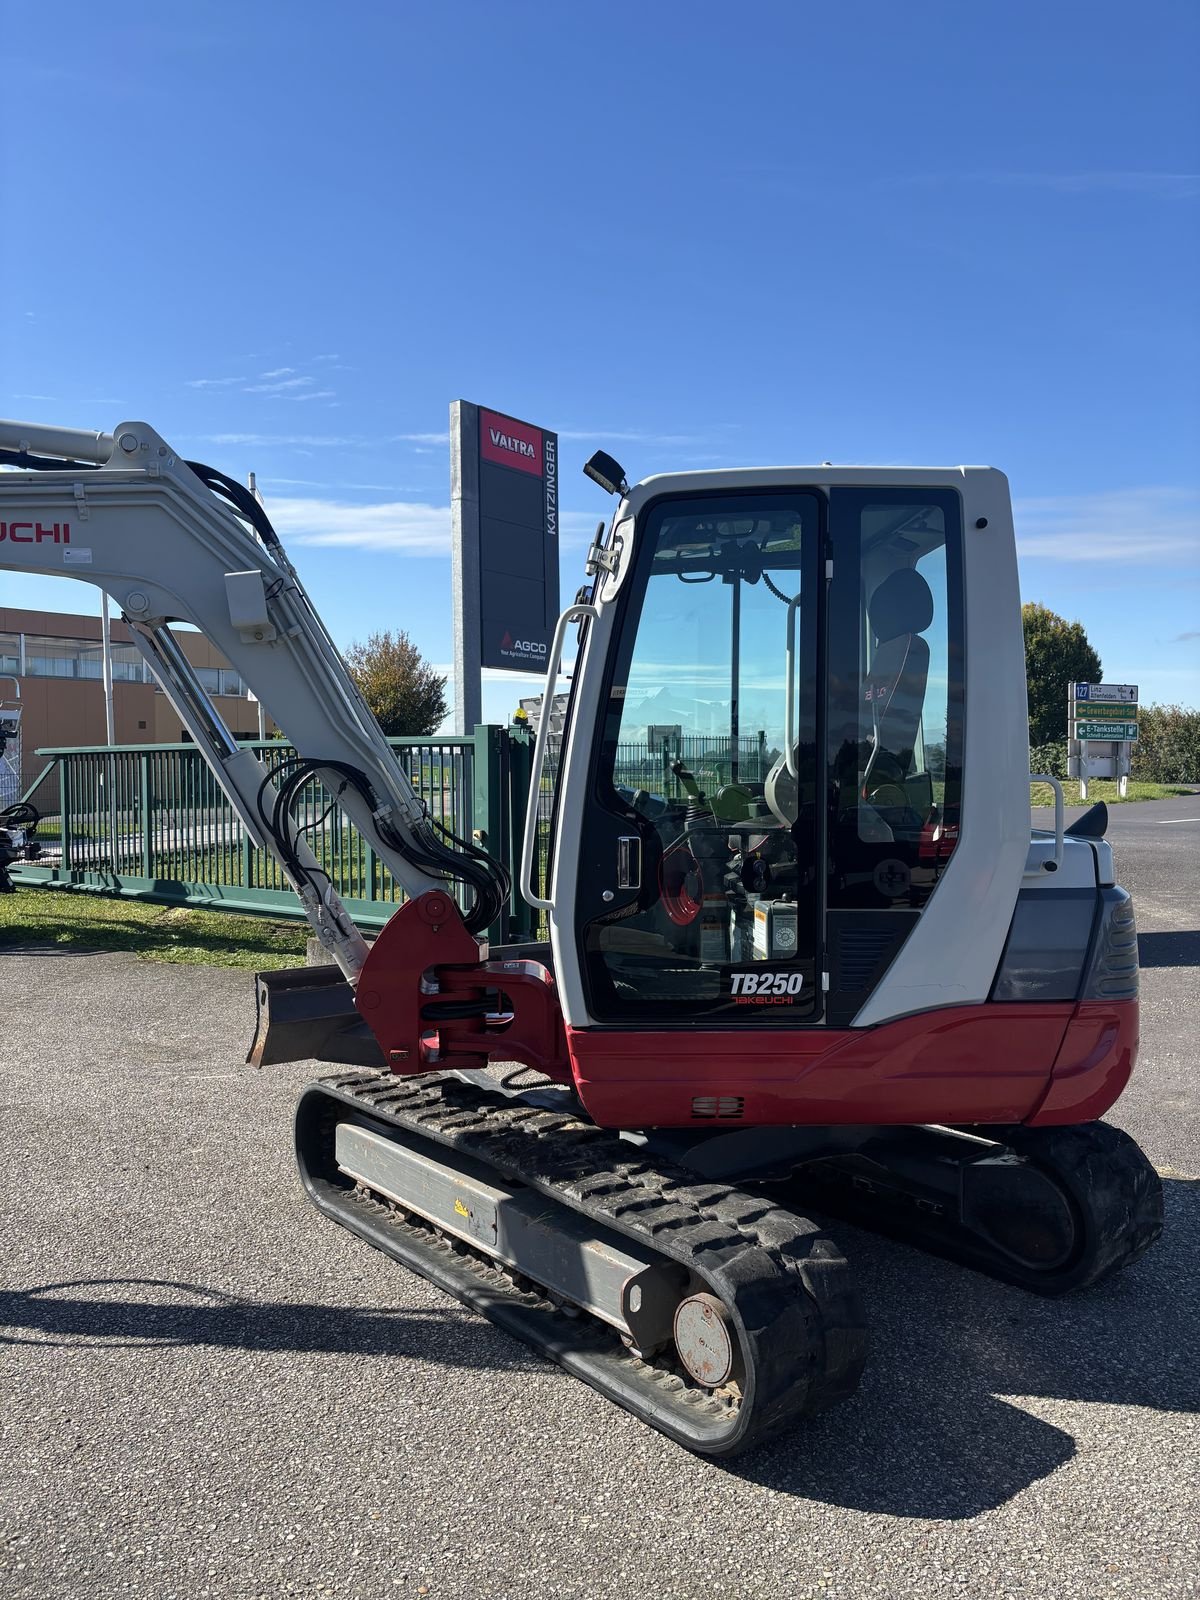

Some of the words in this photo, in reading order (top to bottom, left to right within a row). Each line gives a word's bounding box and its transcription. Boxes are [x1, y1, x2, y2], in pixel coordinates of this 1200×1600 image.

[489, 428, 536, 458] VALTRA
[546, 440, 556, 535] KATZINGER
[0, 522, 70, 544] CHI
[514, 640, 546, 653] AGCO
[1077, 686, 1088, 696] 127
[1086, 725, 1124, 733] E-Tankstelle
[730, 973, 804, 995] TB250
